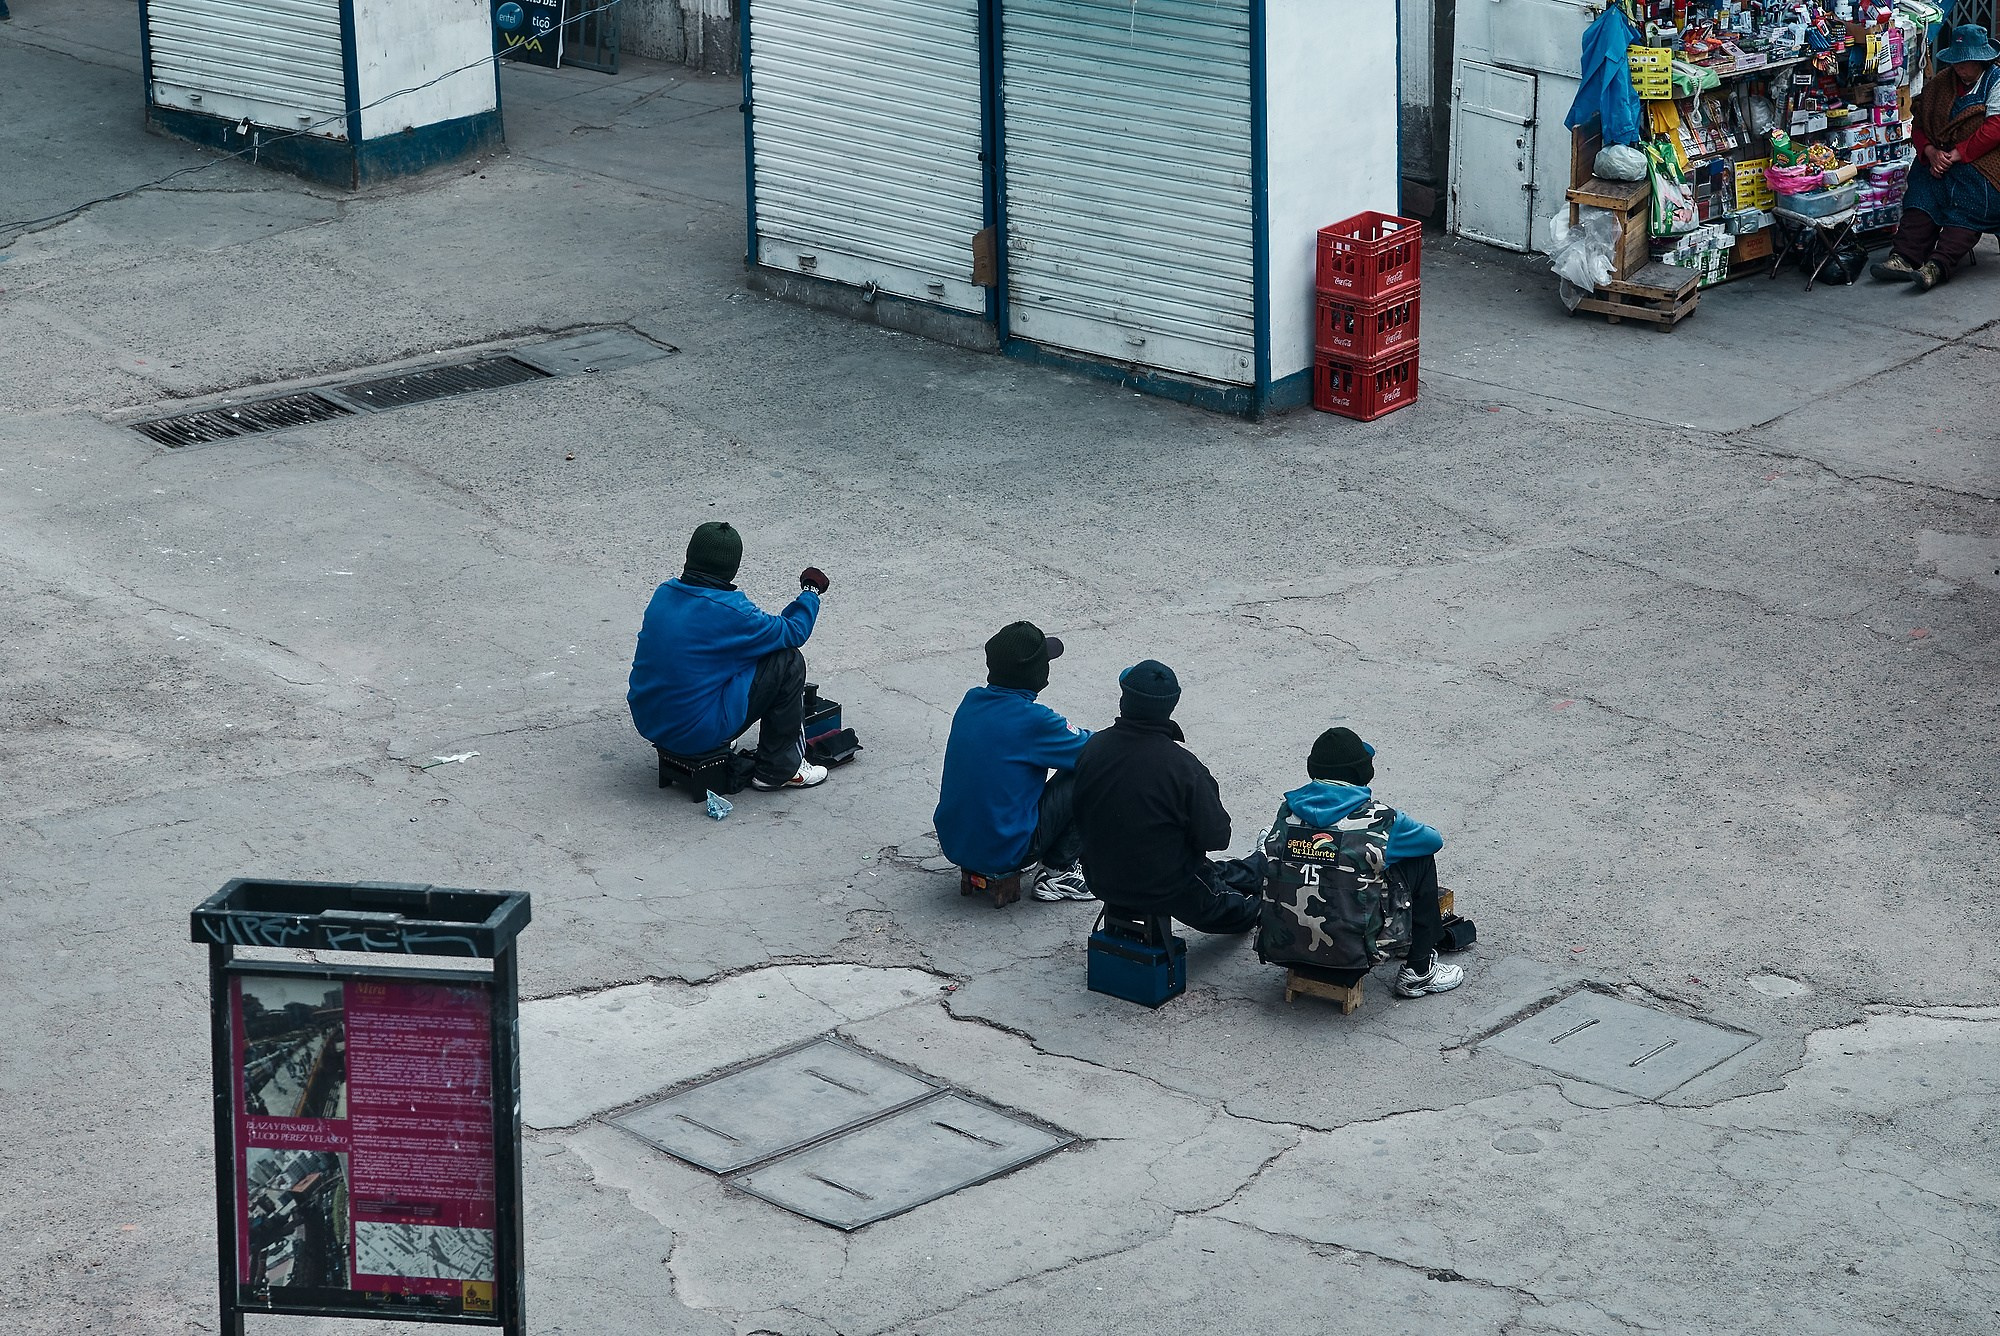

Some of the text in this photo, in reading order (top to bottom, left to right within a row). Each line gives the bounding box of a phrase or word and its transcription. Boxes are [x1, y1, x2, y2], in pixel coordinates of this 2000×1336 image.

[499, 13, 516, 24] entel
[1287, 839, 1313, 848] gente
[1292, 847, 1336, 858] brillante
[1300, 864, 1323, 885] 15
[246, 1121, 273, 1130] PLAZA
[280, 1122, 322, 1132] PASARELA
